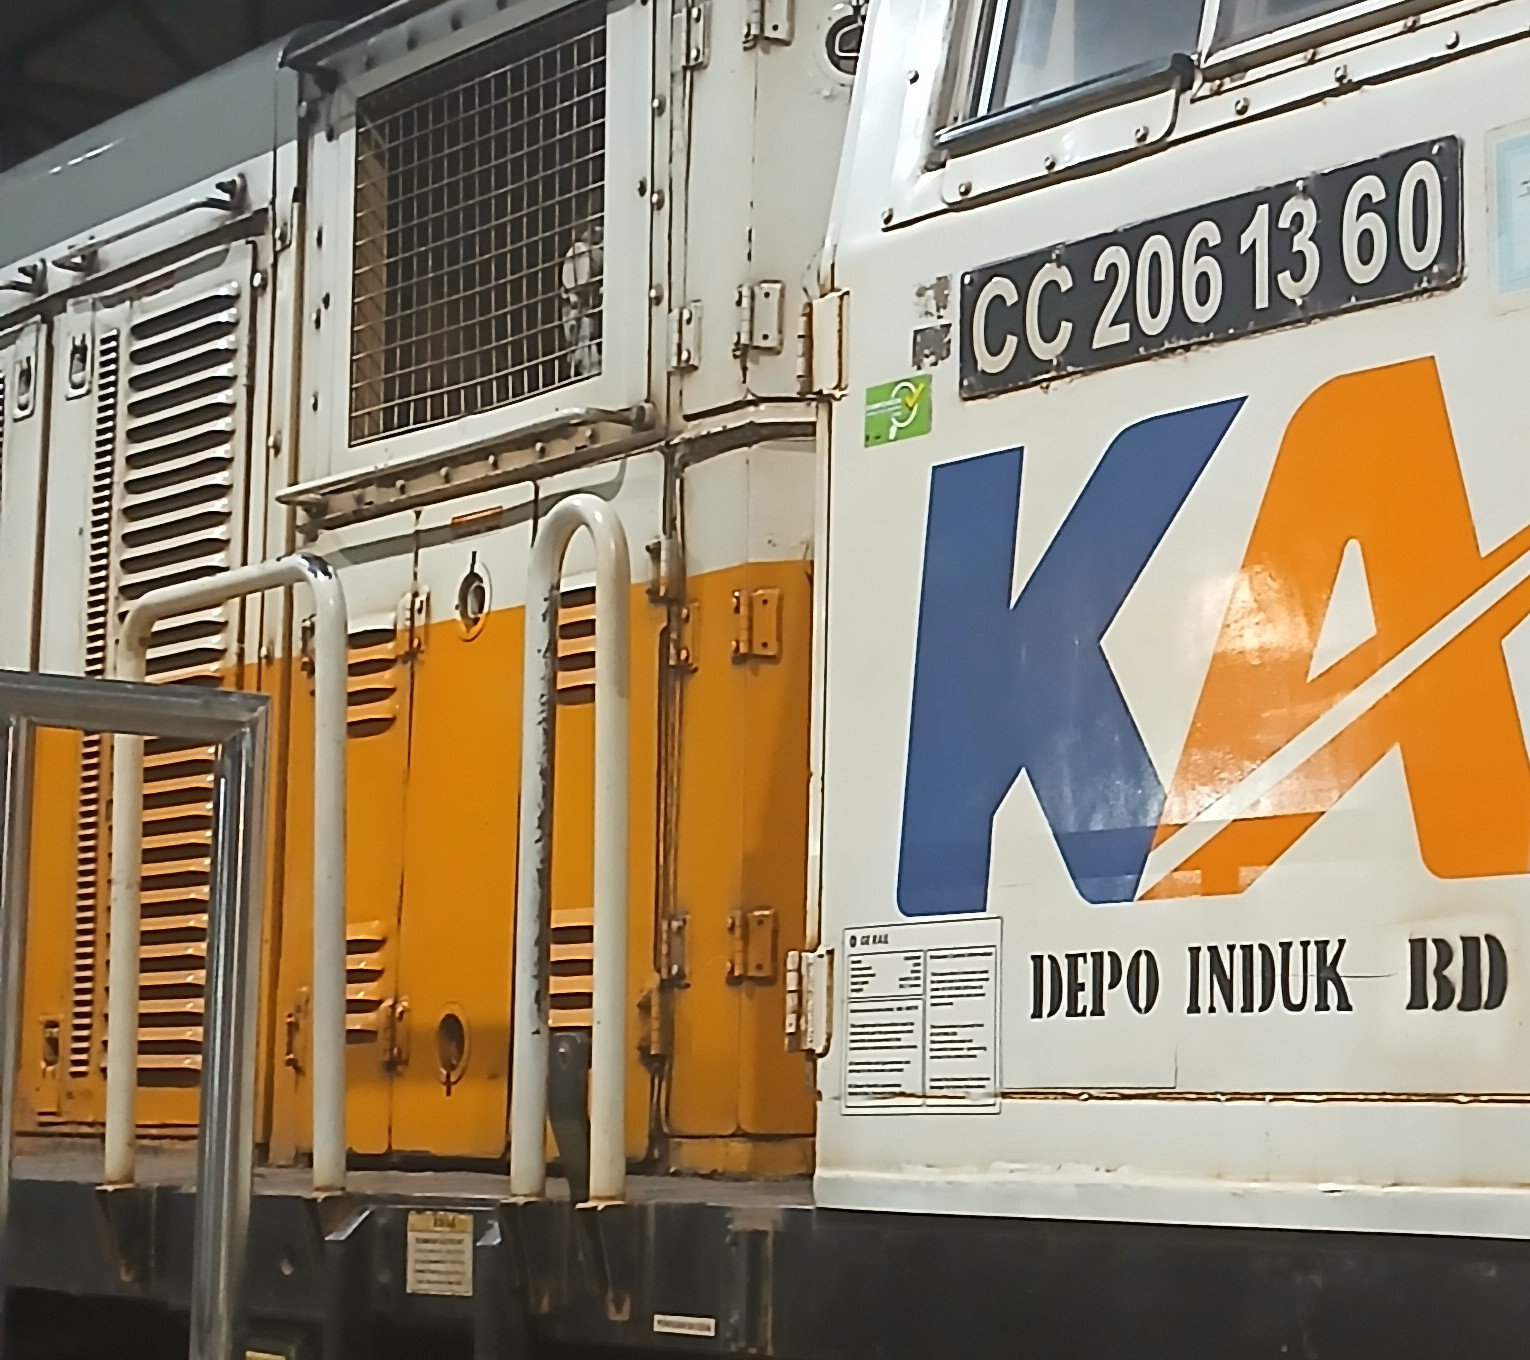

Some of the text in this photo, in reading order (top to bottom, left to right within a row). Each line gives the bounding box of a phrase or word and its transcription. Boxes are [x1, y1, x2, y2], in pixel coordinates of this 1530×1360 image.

[971, 159, 1444, 374] CC 206 13 60
[1030, 949, 1160, 1019] DEPO
[1186, 939, 1353, 1015] INDUK
[1405, 933, 1508, 1012] BD
